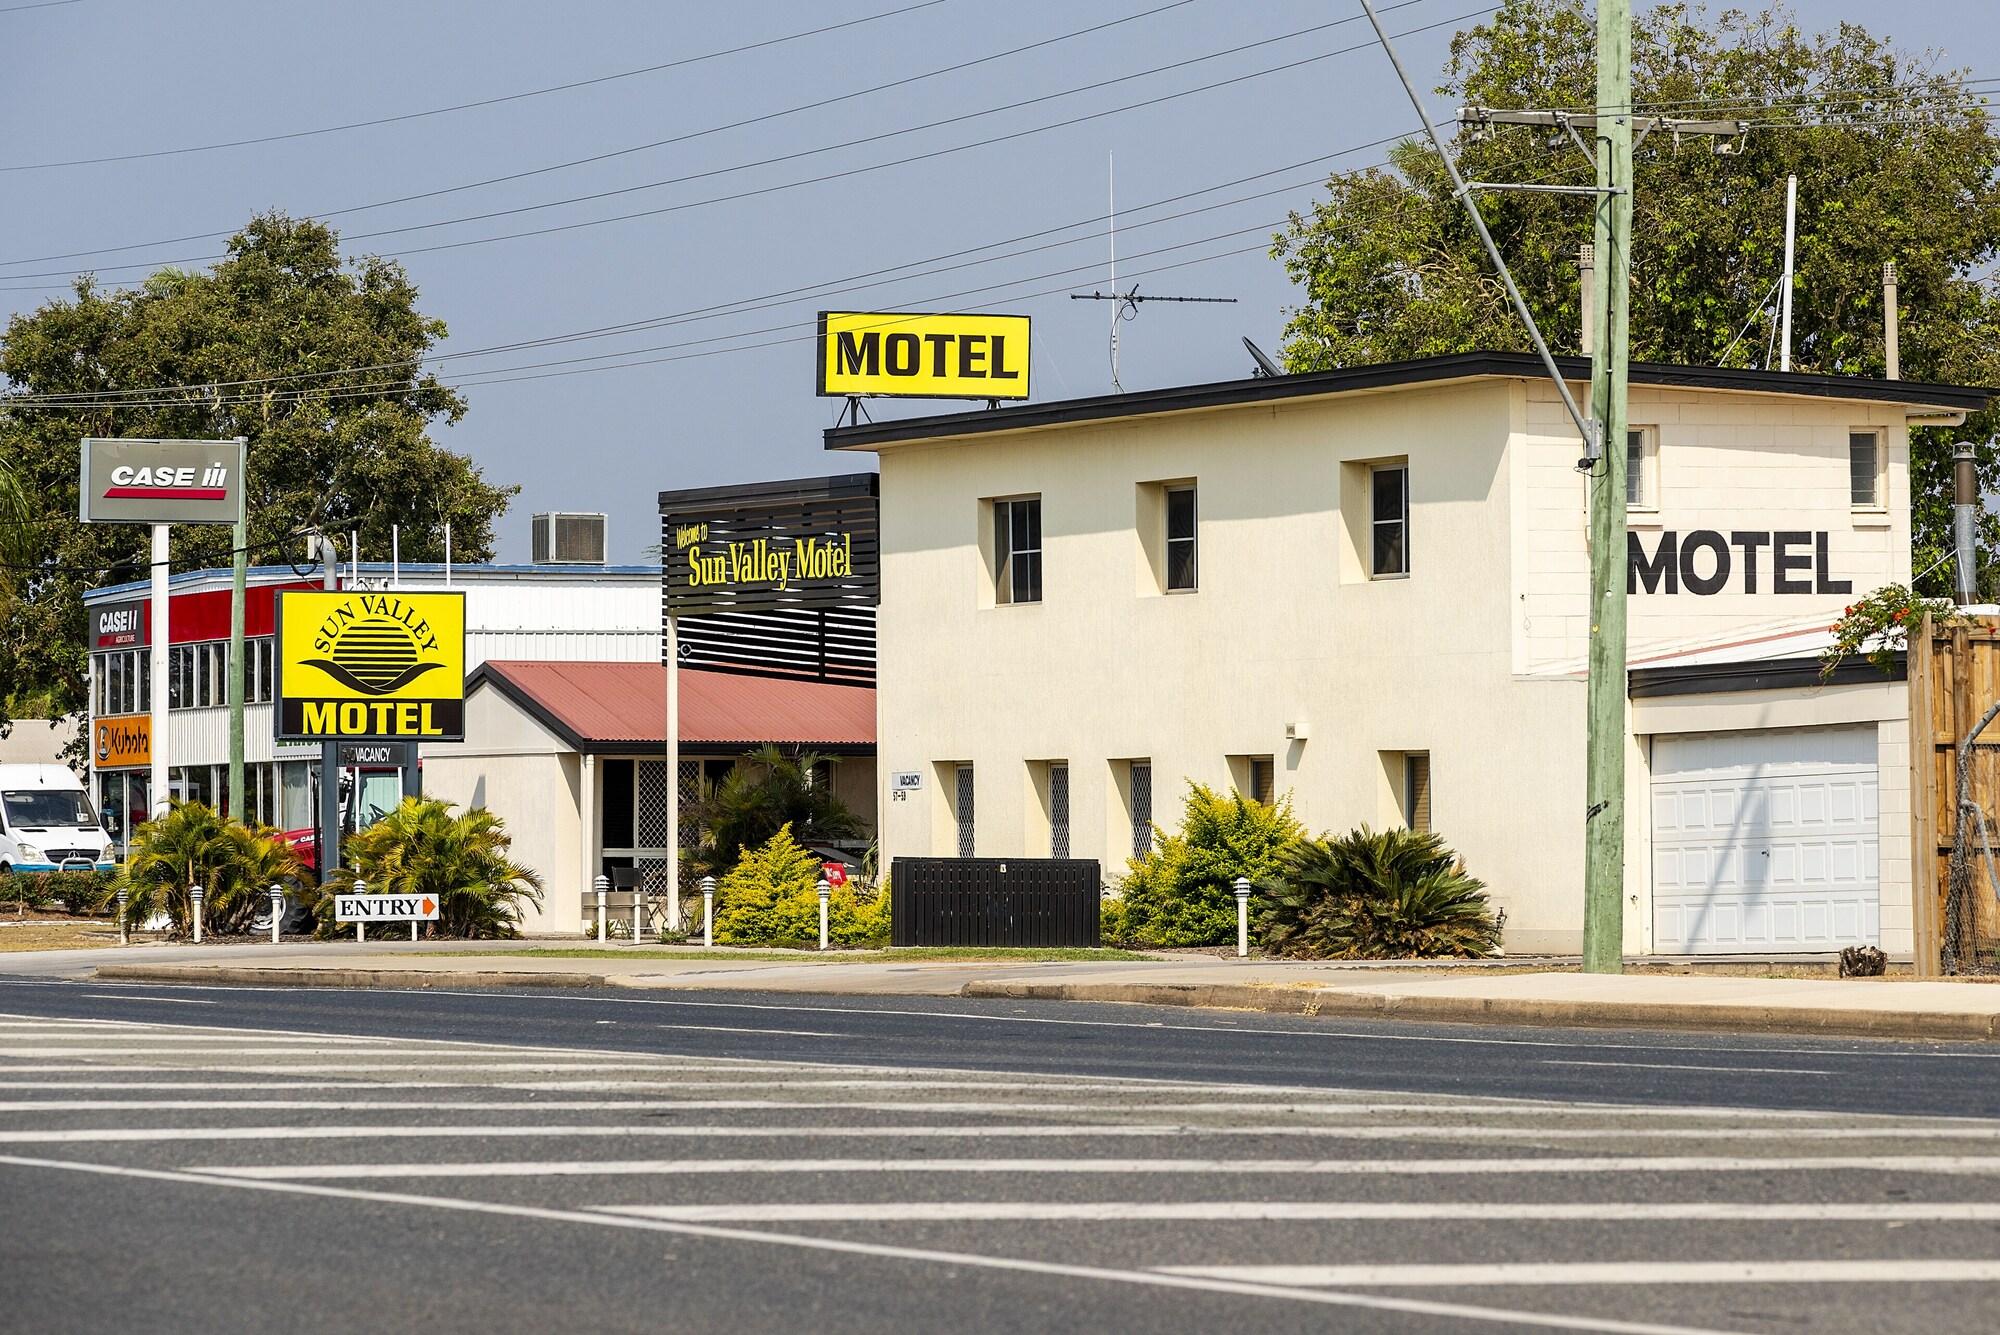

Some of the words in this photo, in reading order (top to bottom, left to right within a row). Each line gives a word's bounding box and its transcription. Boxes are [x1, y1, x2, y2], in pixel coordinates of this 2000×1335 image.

[836, 331, 1019, 379] MOTEL
[111, 466, 196, 487] CASE
[676, 523, 700, 550] Welcome
[700, 522, 708, 541] to
[689, 546, 727, 587] Sun
[729, 538, 792, 591] Valley
[795, 532, 852, 579] Motel
[1626, 529, 1853, 596] MOTEL
[99, 611, 128, 633] CASE
[314, 601, 356, 653] SUN
[360, 595, 439, 653] VALLEY
[302, 702, 443, 735] MOTEL
[111, 726, 149, 755] Kubota
[355, 747, 391, 762] VACANCY
[899, 774, 921, 786] VACANCY
[340, 899, 421, 916] ENTRY
